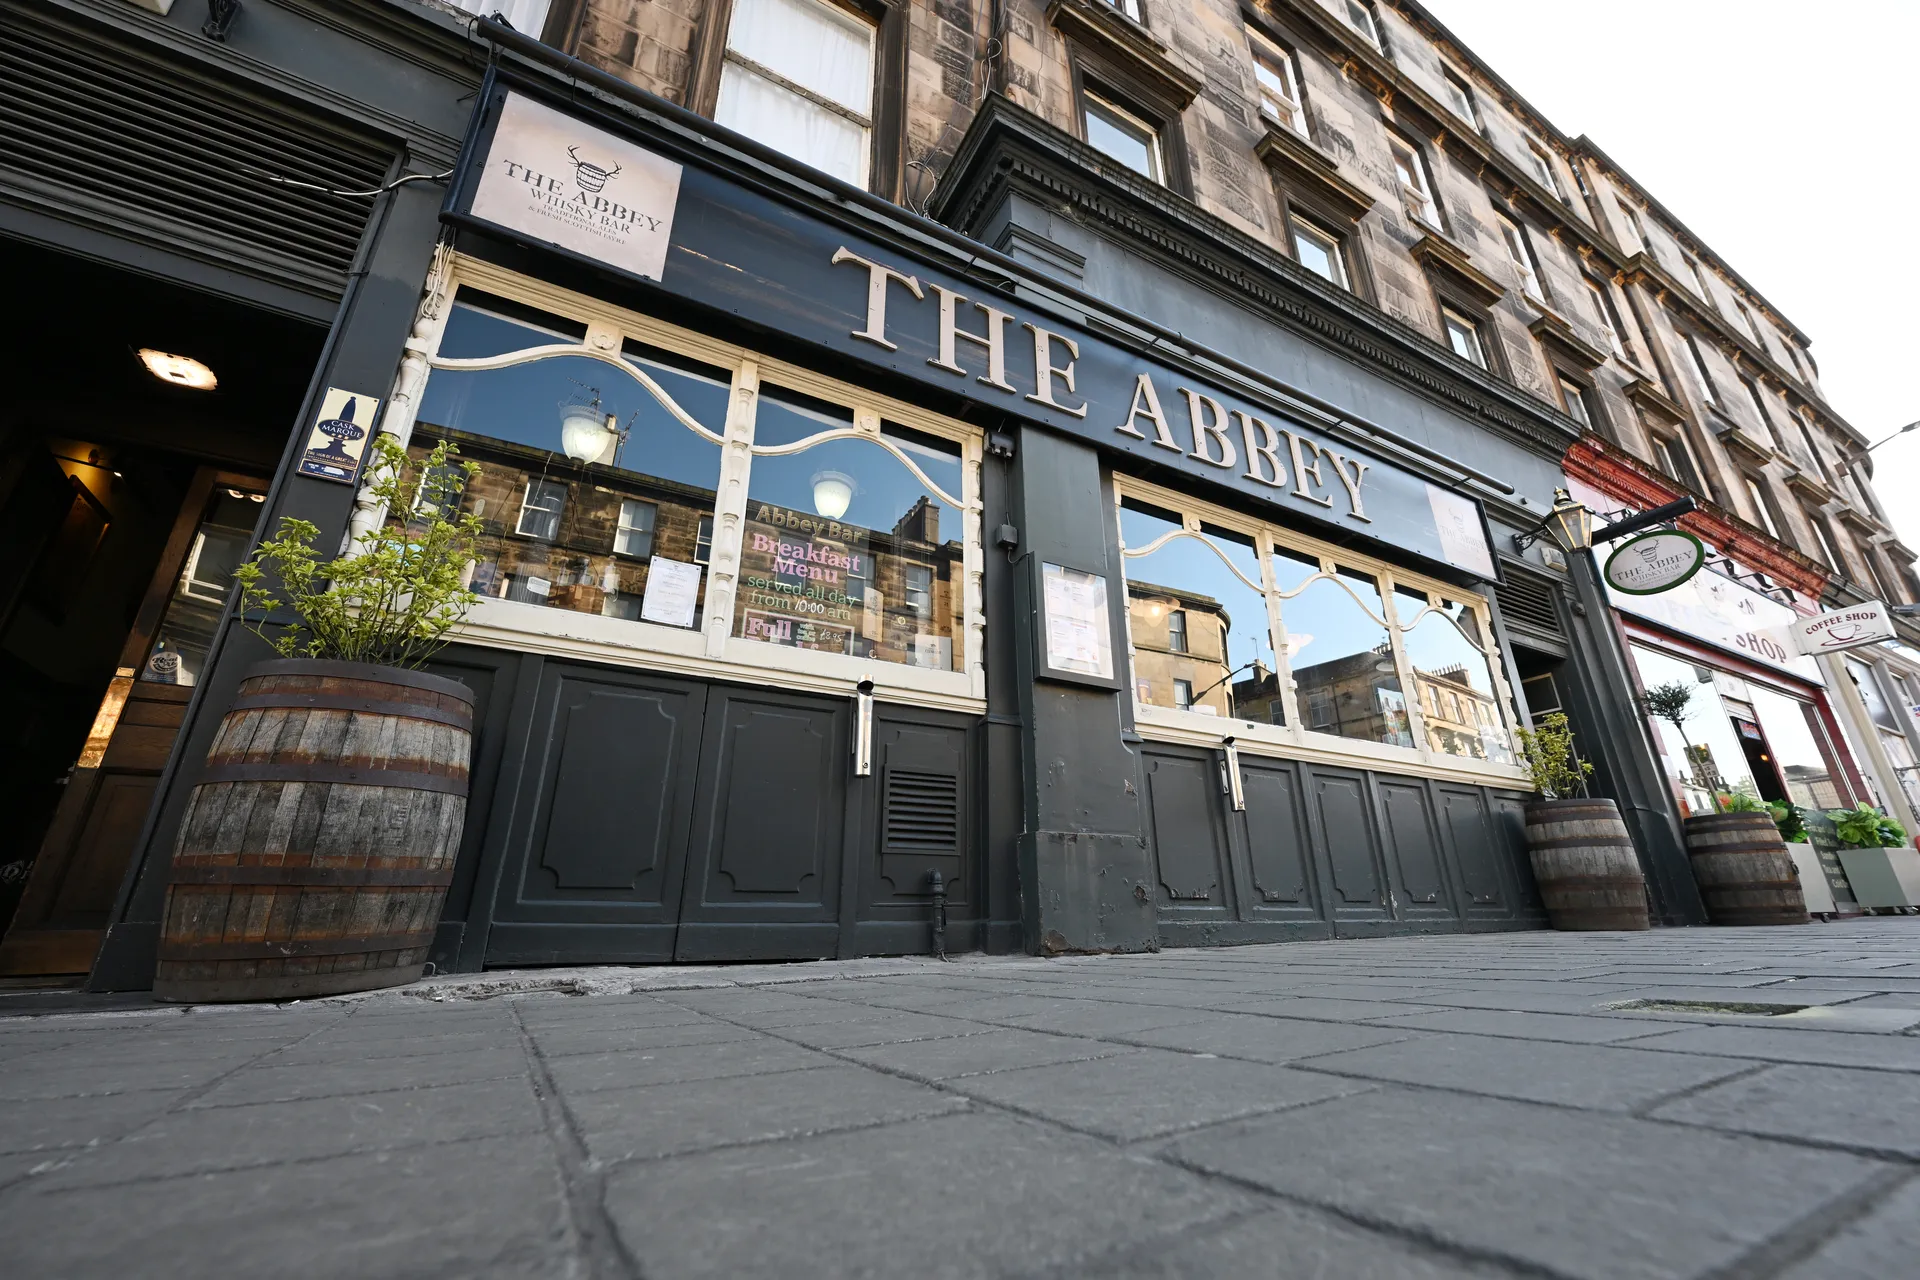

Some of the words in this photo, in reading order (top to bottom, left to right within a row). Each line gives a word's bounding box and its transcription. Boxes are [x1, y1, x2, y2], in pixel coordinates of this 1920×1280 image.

[503, 159, 564, 197] THE
[572, 190, 664, 233] ABBEY
[530, 188, 597, 220] WHISKY
[600, 215, 632, 235] BAR
[537, 208, 561, 221] FRESH
[564, 218, 602, 236] SCOTTISH
[543, 204, 597, 228] TRADITIONAL
[597, 226, 617, 236] ALES
[831, 245, 1089, 419] THE
[1115, 372, 1373, 524] ABBEY
[321, 424, 362, 438] MARQUE
[331, 420, 355, 431] CASK
[756, 505, 825, 538] Abbey
[828, 521, 863, 543] Bar
[752, 533, 861, 572] Breakfast
[1614, 566, 1643, 581] THE
[1647, 550, 1693, 571] ABBEY
[771, 554, 839, 584] Menu
[1631, 568, 1662, 583] WHISKY
[1664, 564, 1681, 573] BAR
[747, 576, 803, 596] served
[806, 586, 825, 601] all
[828, 589, 857, 608] day
[751, 590, 791, 610] from
[794, 600, 825, 614] 10:00
[827, 605, 852, 621] am
[747, 617, 792, 641] Full
[1805, 615, 1843, 635] COFFEE
[1845, 611, 1878, 622] SHOP
